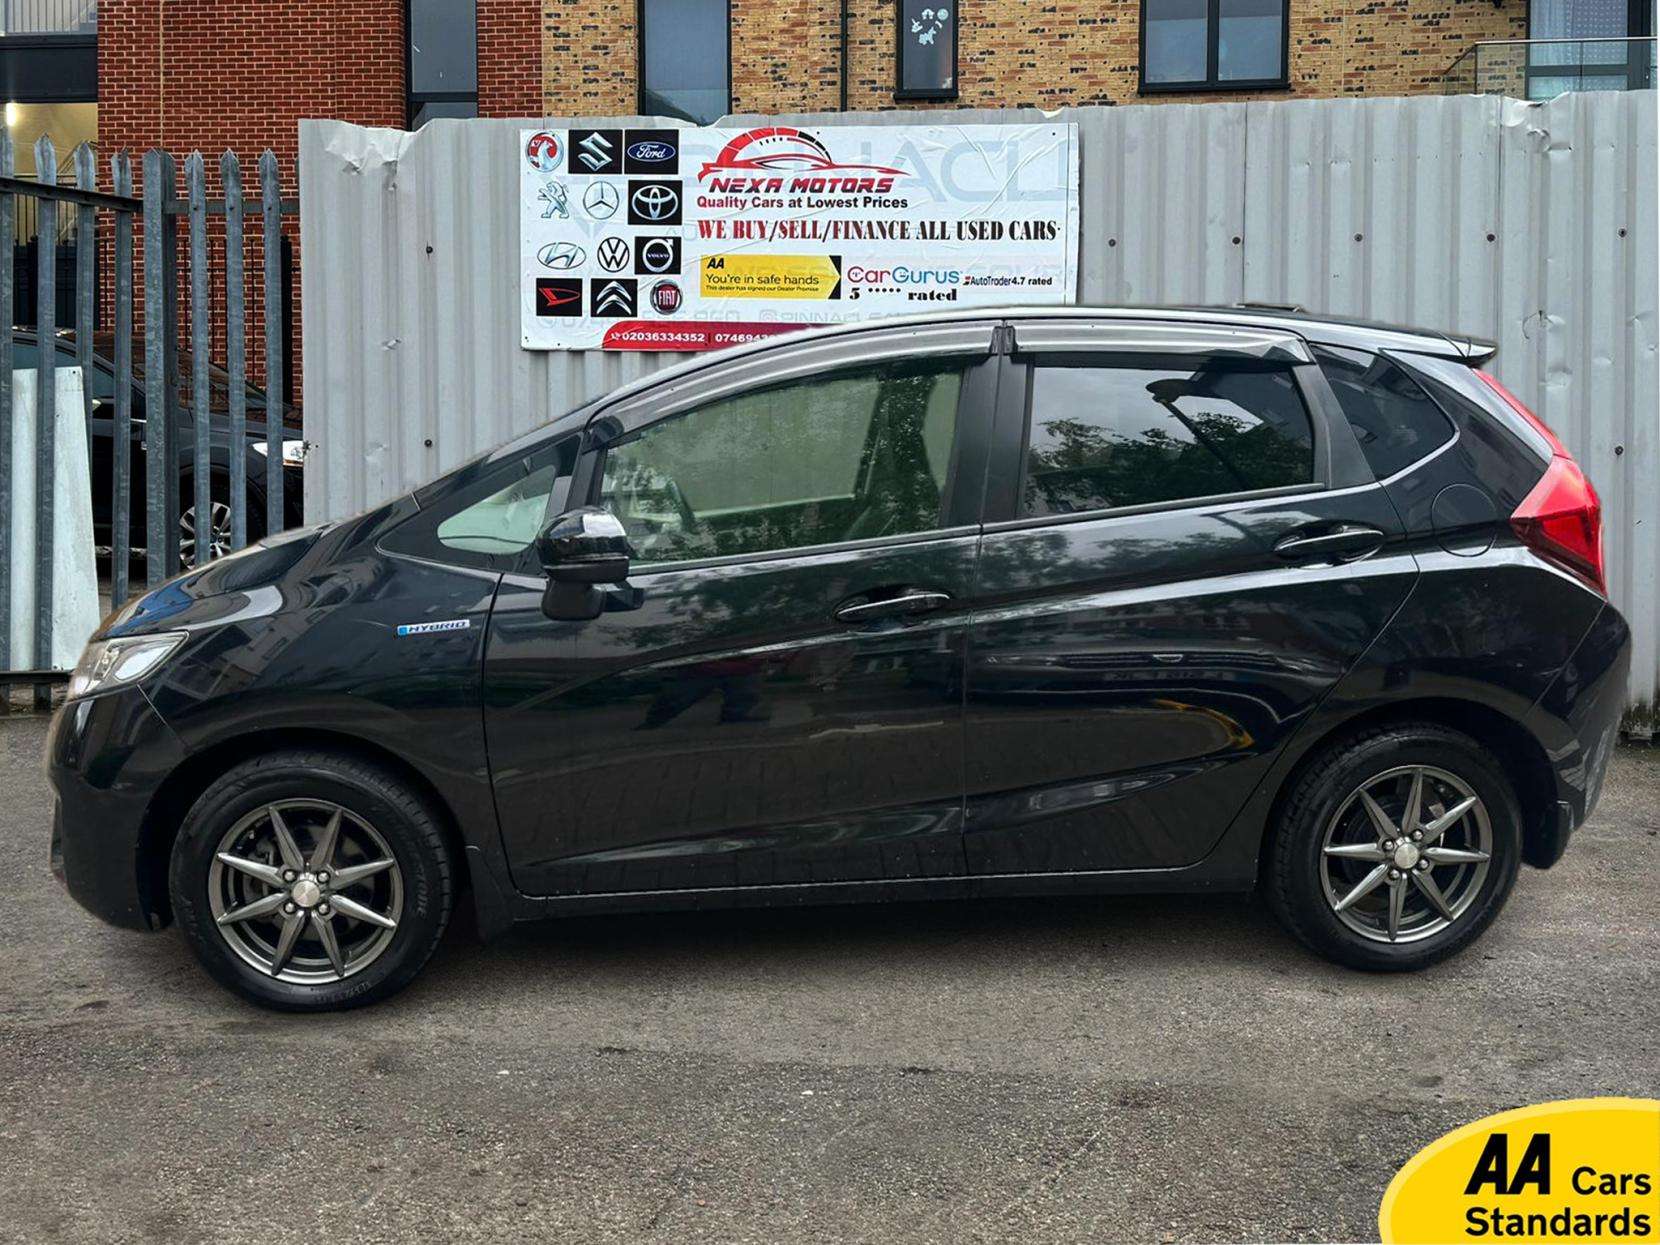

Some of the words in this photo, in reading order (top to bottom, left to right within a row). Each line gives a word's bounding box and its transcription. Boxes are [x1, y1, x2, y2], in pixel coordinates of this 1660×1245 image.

[636, 143, 666, 159] Ford
[709, 177, 783, 193] NEXA
[789, 177, 894, 193] MOTORS
[697, 196, 746, 210] Quality
[752, 196, 784, 208] Cars
[789, 197, 802, 208] at
[807, 196, 859, 208] Lowest
[863, 196, 908, 208] Prices
[698, 220, 726, 240] WE
[733, 220, 910, 242] BUY/SELL/FINANCE
[916, 220, 950, 240] ALL
[957, 220, 1003, 240] USED
[707, 257, 725, 269] AA
[706, 273, 741, 284] You're
[744, 274, 754, 284] in
[757, 274, 781, 284] safe
[784, 274, 819, 285] hands
[847, 266, 960, 284] CarGurus
[1028, 277, 1053, 285] rated
[658, 290, 676, 305] FIAT
[849, 287, 860, 300] 5
[908, 288, 957, 300] rated
[622, 332, 705, 342] 02036334352
[409, 621, 466, 633] HYBRID
